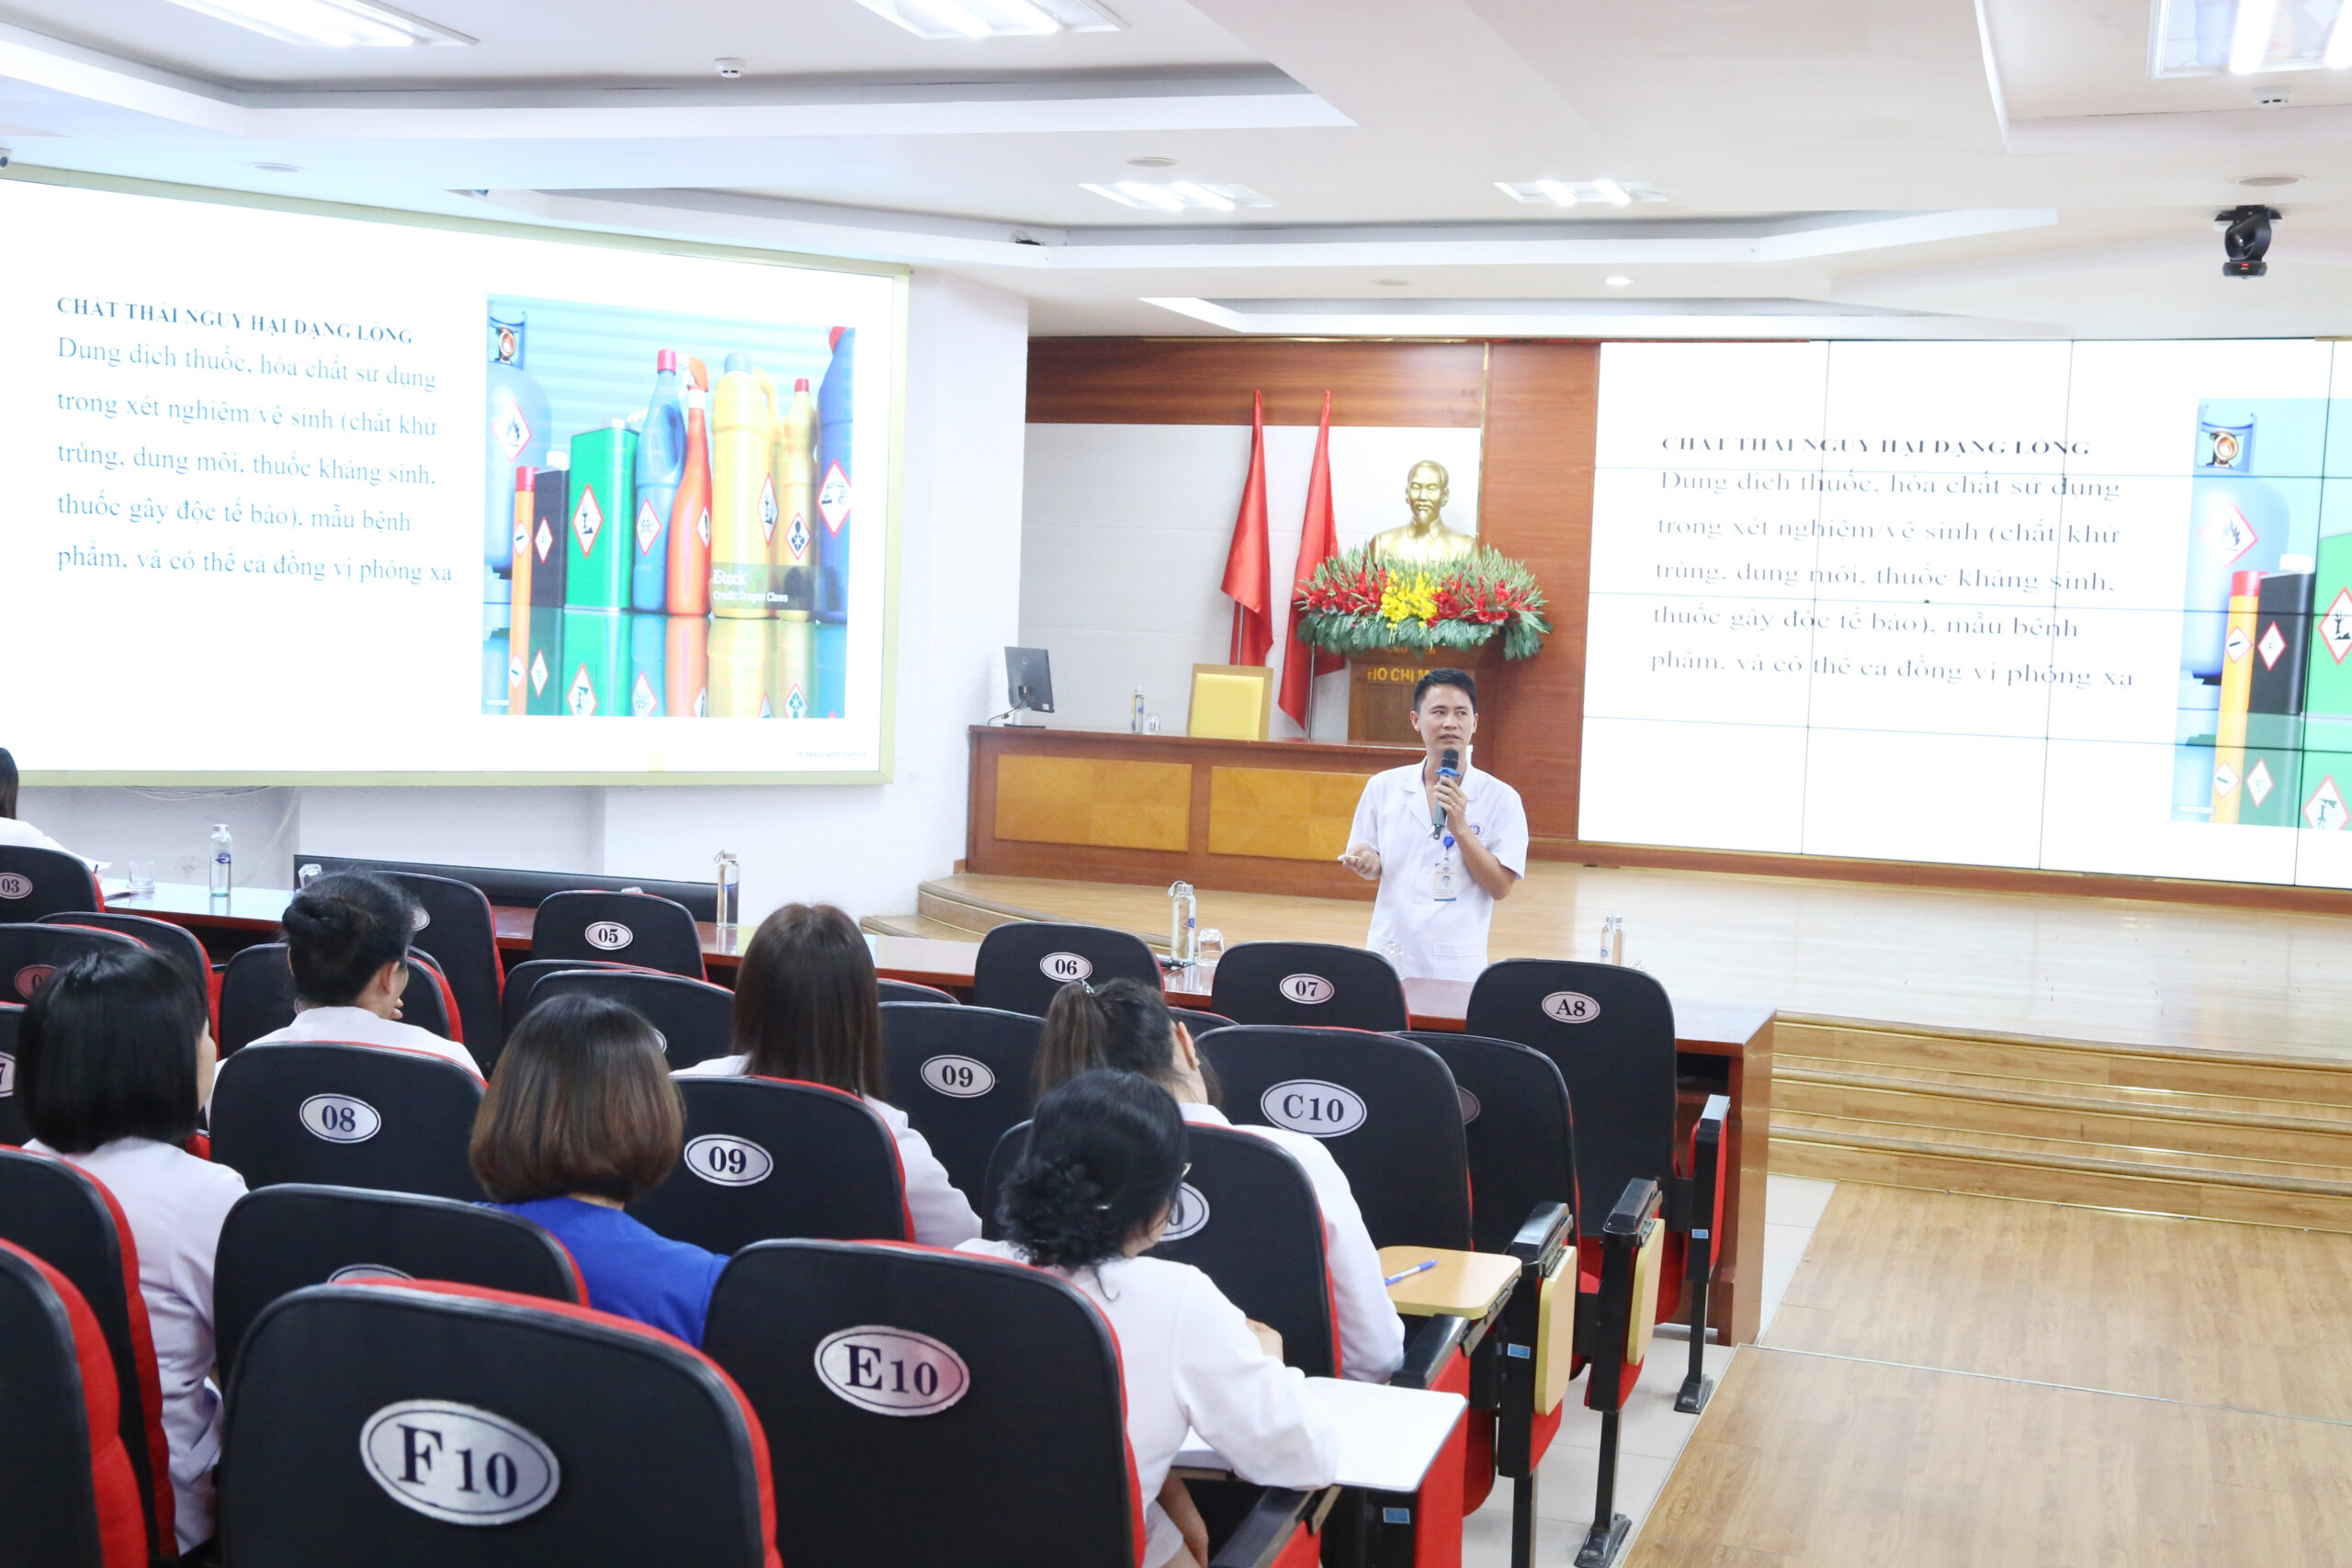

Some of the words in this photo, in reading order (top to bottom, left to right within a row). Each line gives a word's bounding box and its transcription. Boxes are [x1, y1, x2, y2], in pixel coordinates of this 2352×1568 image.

[185, 309, 244, 329] NGUY
[251, 315, 287, 336] HẠI
[294, 319, 351, 340] DẠNG
[59, 336, 121, 367] Dung
[130, 344, 176, 367] dịch
[186, 345, 252, 374] thuốc,
[261, 354, 298, 376] hóa
[305, 355, 348, 380] chất
[386, 365, 436, 392] dụng
[57, 393, 118, 419] trong
[126, 395, 160, 416] xét
[291, 407, 334, 429] sinh
[341, 407, 391, 434] (chất
[1804, 438, 1871, 453] NGUY
[1882, 439, 1925, 457] HẠI
[1935, 440, 2006, 457] DẠNG
[58, 443, 125, 470] trùng,
[133, 446, 189, 475] dung
[197, 451, 244, 473] môi,
[253, 451, 311, 477] thuốc
[319, 458, 381, 486] kháng
[389, 464, 435, 486] sinh,
[1661, 472, 1727, 494] Dung
[1737, 472, 1790, 492] dịch
[1802, 468, 1879, 492] thuốc,
[1890, 475, 1936, 493] hóa
[1946, 470, 2000, 494] chất
[2052, 477, 2120, 501] dụng
[58, 490, 120, 516] thuốc
[130, 497, 169, 524] gây
[176, 500, 216, 525] độc
[224, 497, 243, 522] tế
[363, 510, 411, 533] bệnh
[1657, 519, 1722, 539] trong
[1733, 518, 1768, 536] xét
[1925, 522, 1978, 540] sinh
[1989, 518, 2054, 543] (chất
[137, 549, 161, 570] và
[169, 550, 195, 570] có
[273, 549, 325, 581] đồng
[334, 558, 352, 581] vị
[360, 558, 422, 585] phóng
[429, 566, 452, 584] xạ
[713, 570, 745, 586] iStock
[1737, 563, 1799, 586] dung
[1809, 566, 1866, 584] môi,
[1876, 562, 1948, 586] thuốc
[1959, 569, 2039, 593] kháng
[2050, 570, 2115, 592] sinh,
[767, 592, 787, 603] Claws
[1654, 603, 1720, 625] thuốc
[1730, 609, 1773, 631] gây
[1783, 610, 1829, 631] độc
[1840, 607, 1861, 629] tế
[2013, 617, 2078, 638] bệnh
[1737, 654, 1763, 671] và
[1773, 655, 1802, 672] có
[1973, 663, 1996, 683] vị
[2007, 664, 2091, 689] phóng
[2, 879, 19, 894] 03
[598, 928, 618, 943] 05
[1055, 959, 1078, 976] 06
[1295, 980, 1318, 998] 07
[1555, 998, 1587, 1018] A8
[941, 1065, 974, 1089] 09
[321, 1105, 356, 1133] 08
[1283, 1093, 1344, 1123] C10
[708, 1146, 748, 1175] 09
[842, 1343, 938, 1397] E10
